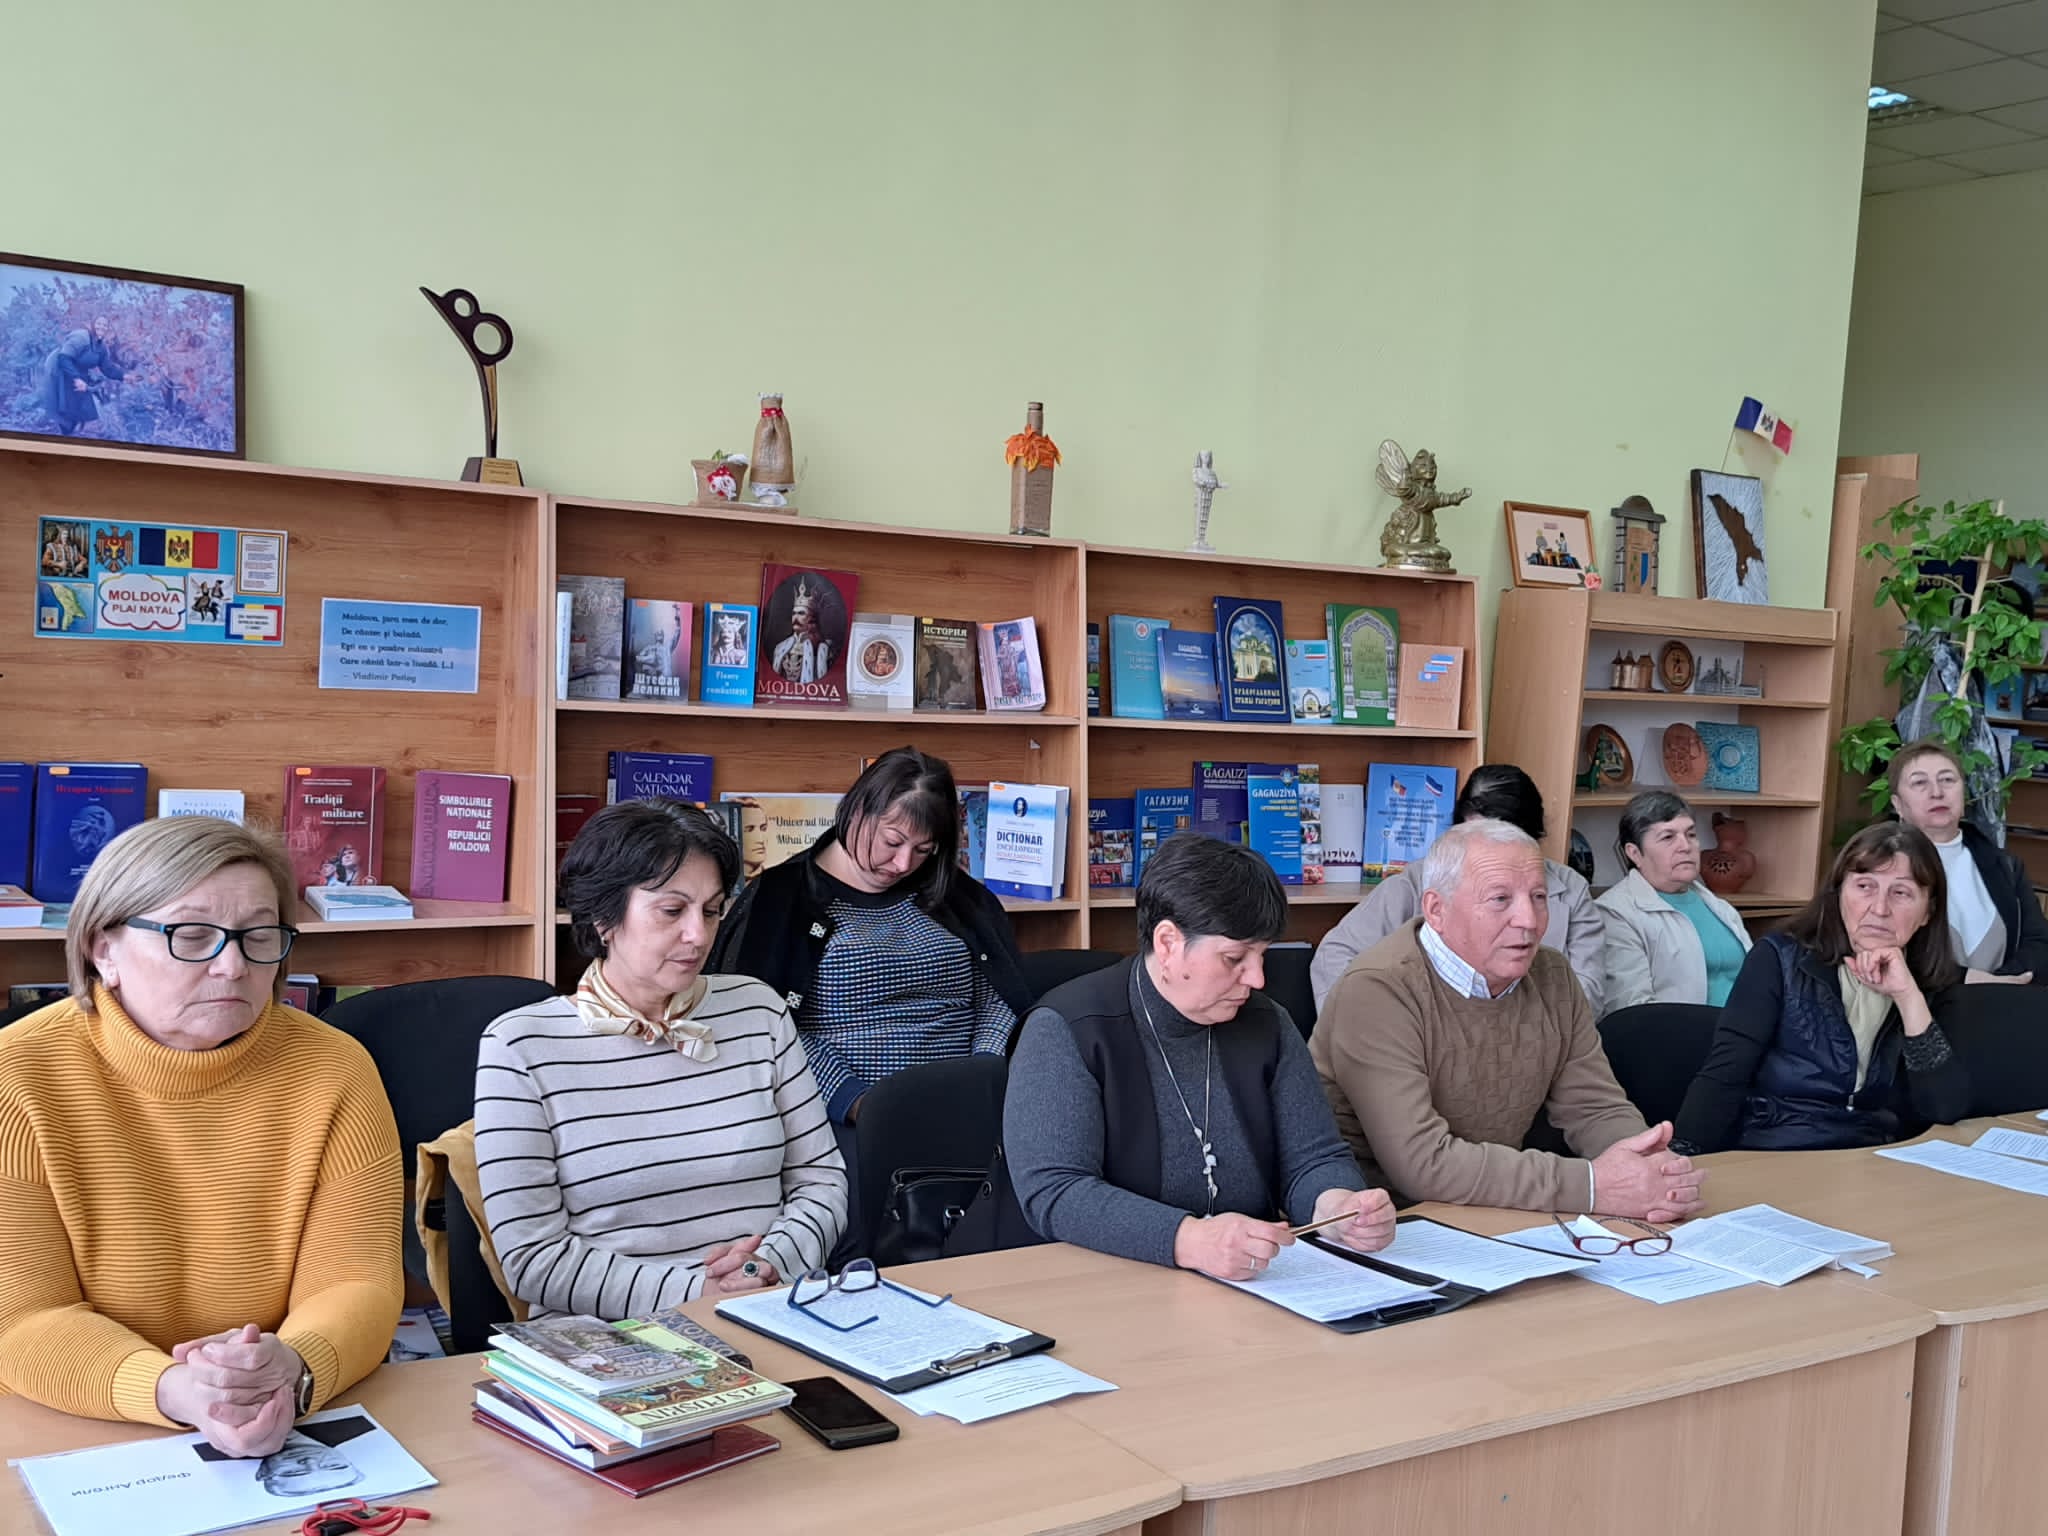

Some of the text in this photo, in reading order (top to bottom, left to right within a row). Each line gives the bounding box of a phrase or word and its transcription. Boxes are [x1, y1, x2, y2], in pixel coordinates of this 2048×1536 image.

[108, 590, 180, 603] MOLDOVA
[112, 604, 176, 615] PLAI NATAL
[923, 625, 967, 637] ИСТОРИЯ
[634, 673, 680, 687] Штефан
[632, 684, 680, 697] Великий
[758, 680, 841, 698] MOLDOVA
[632, 771, 694, 785] CALENDAR
[439, 795, 493, 807] SIMBOLURILE
[1144, 795, 1190, 807] ГАГАУЗИЯ
[322, 808, 364, 818] militare
[476, 820, 492, 830] ALE
[448, 830, 491, 841] REPUBLICII
[448, 841, 490, 853] MOLDOVA
